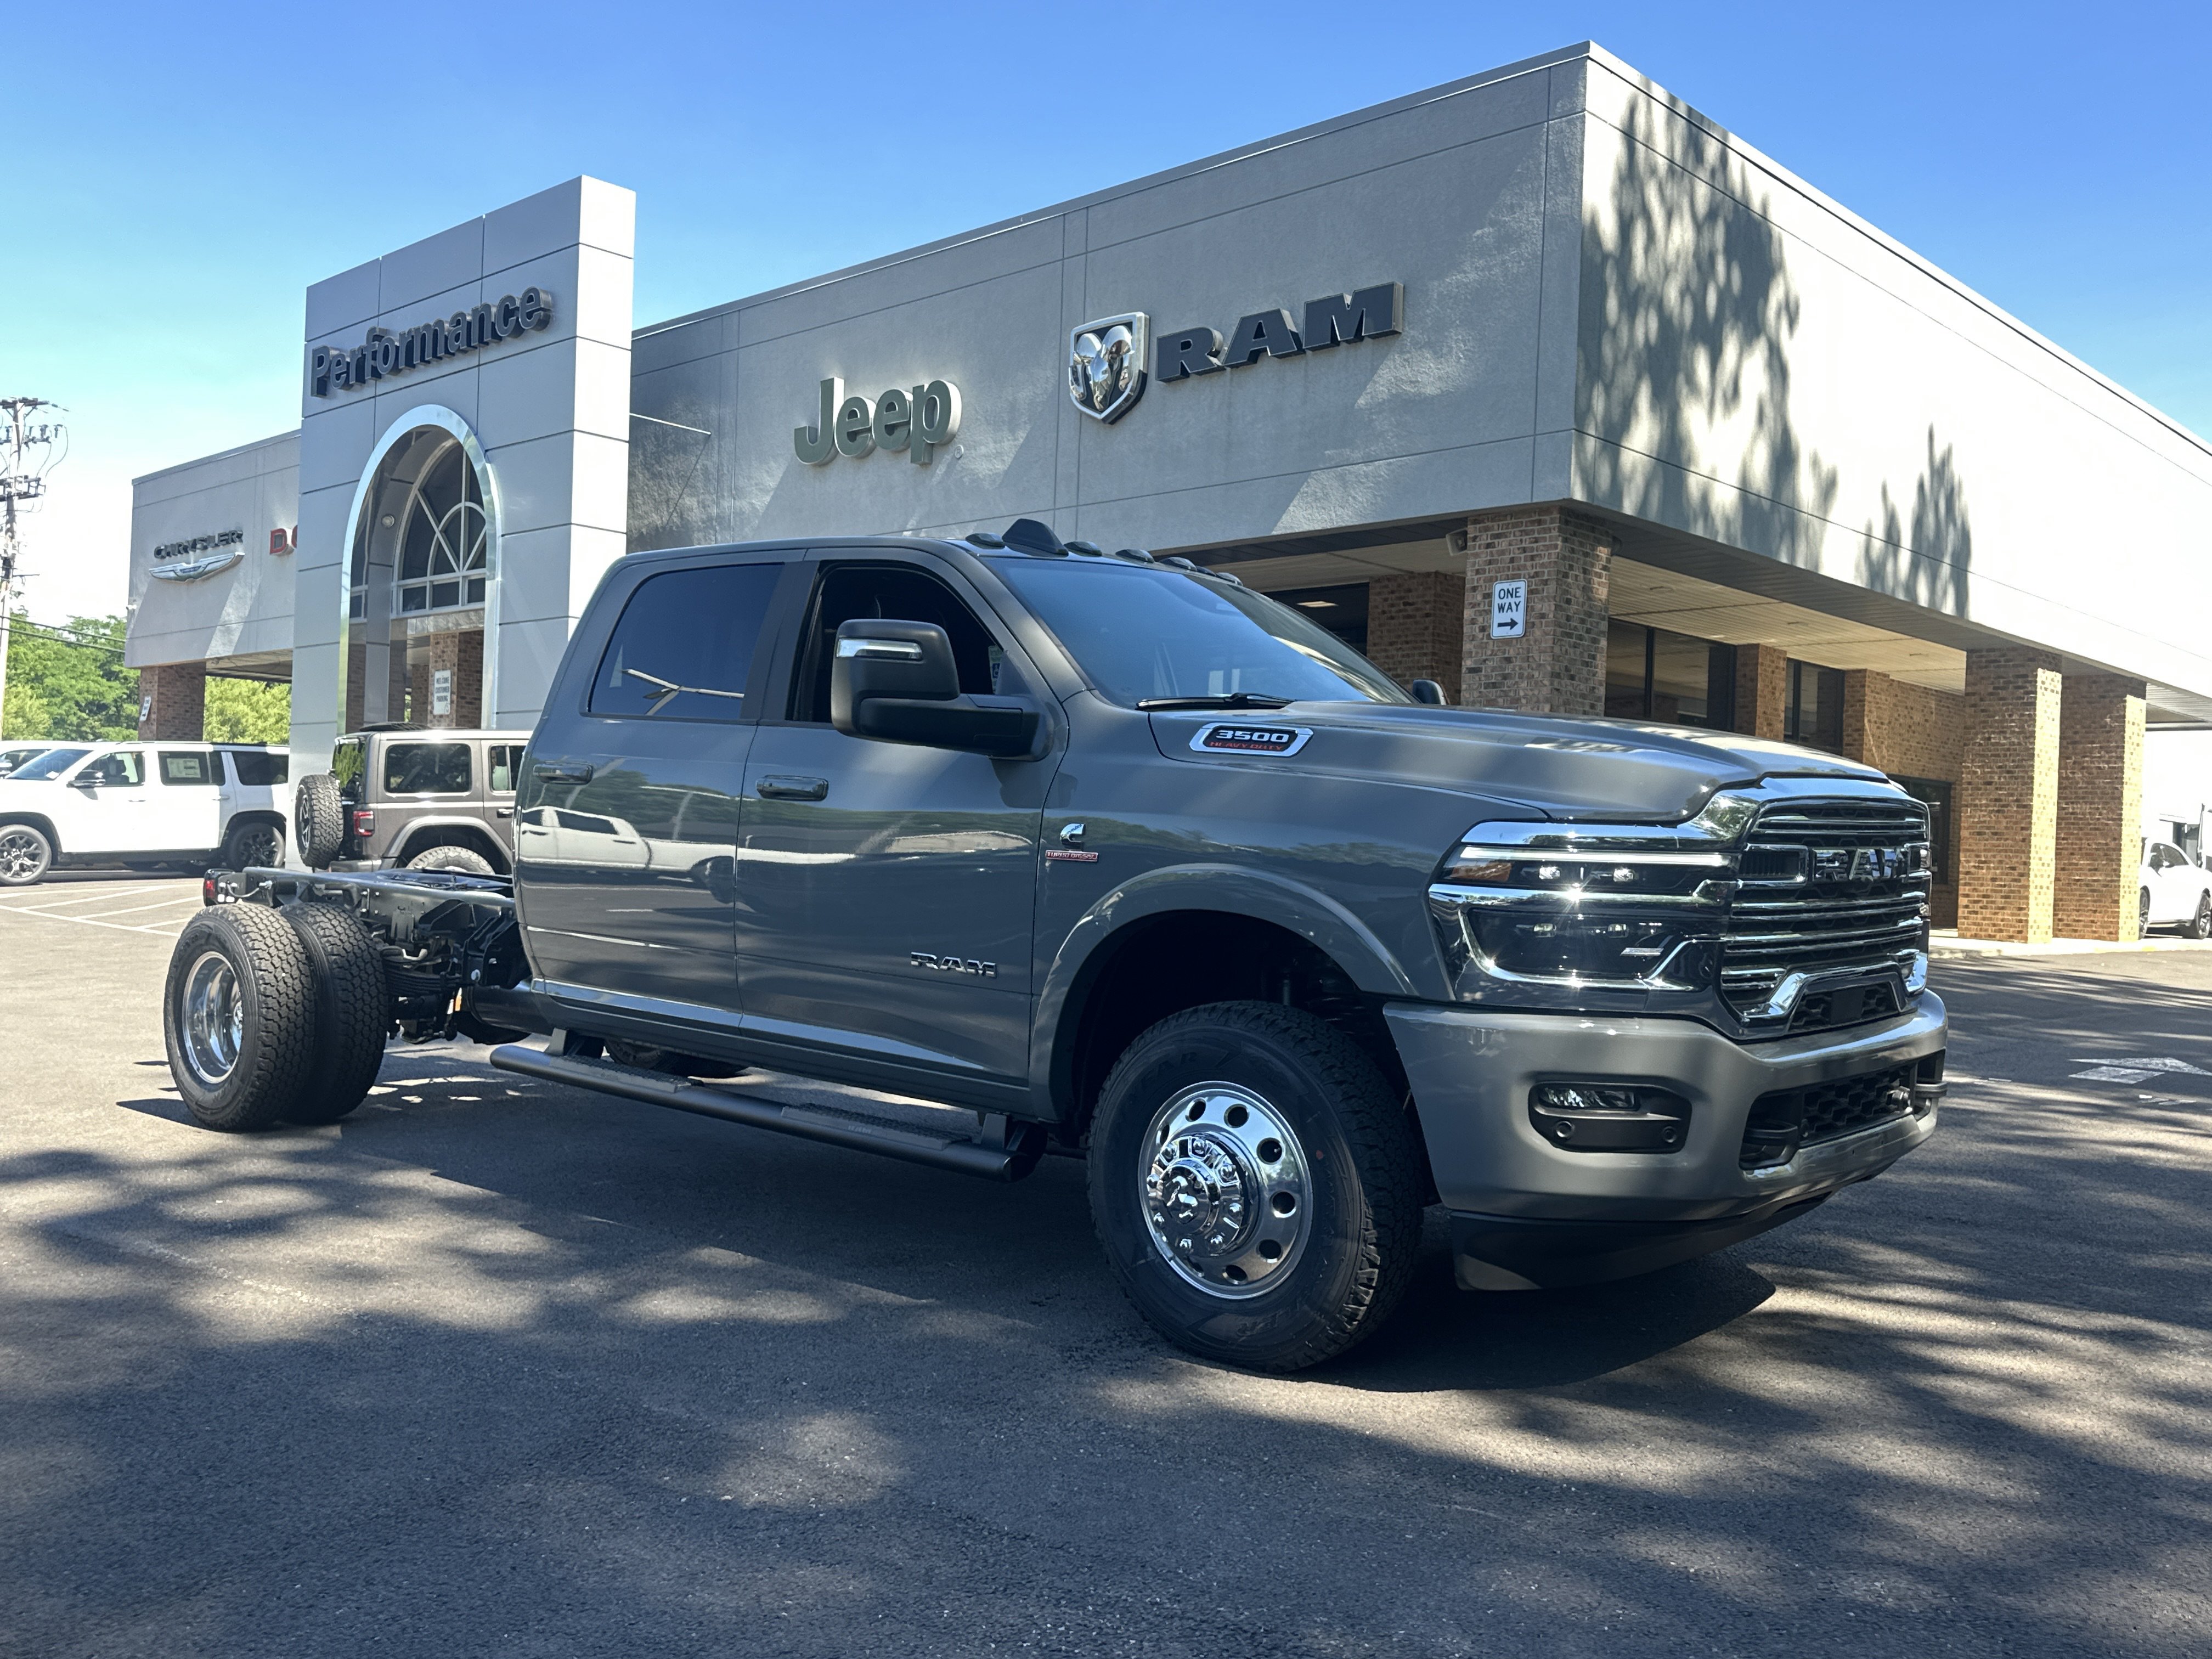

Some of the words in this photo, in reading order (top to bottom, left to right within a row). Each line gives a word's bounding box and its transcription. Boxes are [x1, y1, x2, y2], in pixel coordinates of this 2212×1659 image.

[311, 286, 552, 397] Performance
[1155, 281, 1404, 383] RAM
[794, 377, 962, 465] Jeep
[154, 529, 244, 559] CHRYSLER
[1498, 587, 1521, 600] ONE
[1498, 601, 1521, 613] WAY
[1216, 730, 1289, 743] 3500
[911, 952, 996, 977] RAM
